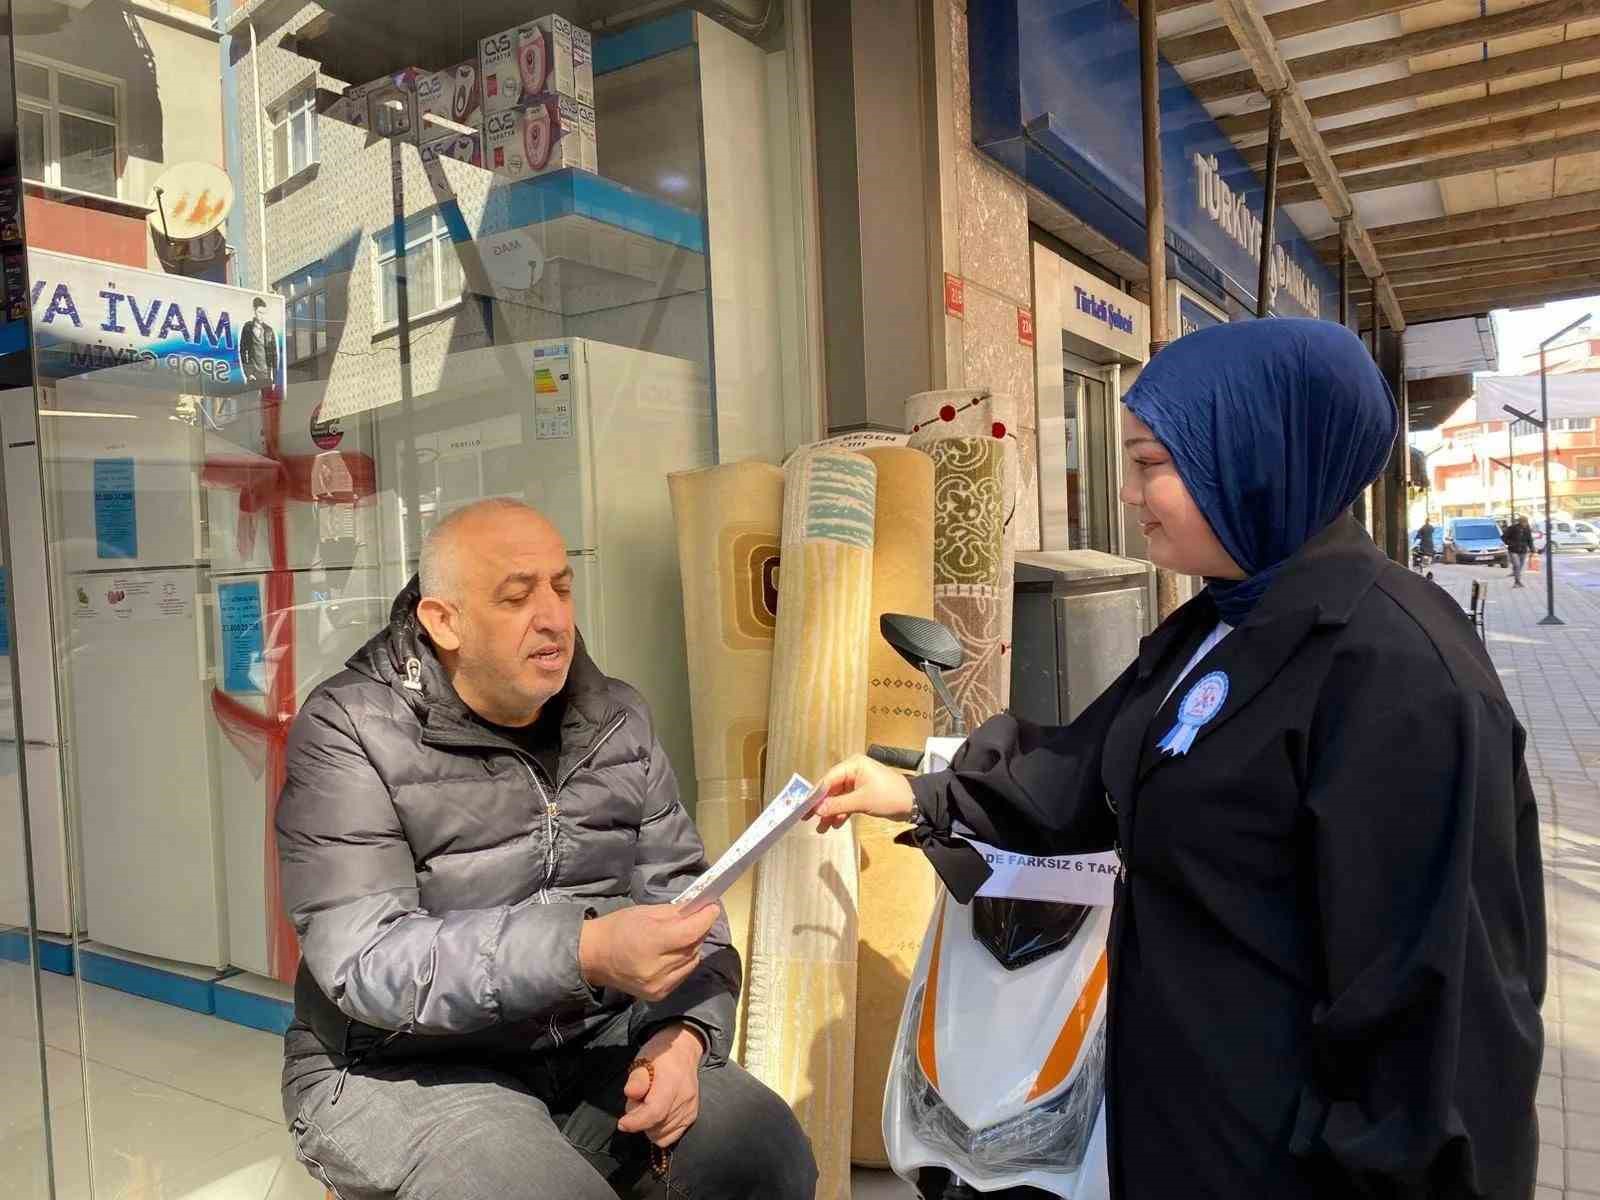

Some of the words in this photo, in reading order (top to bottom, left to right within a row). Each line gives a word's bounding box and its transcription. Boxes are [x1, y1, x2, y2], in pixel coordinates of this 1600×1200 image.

[1008, 856, 1070, 871] FARKSIZ
[1074, 861, 1084, 872] 6
[1088, 862, 1118, 875] TAK
